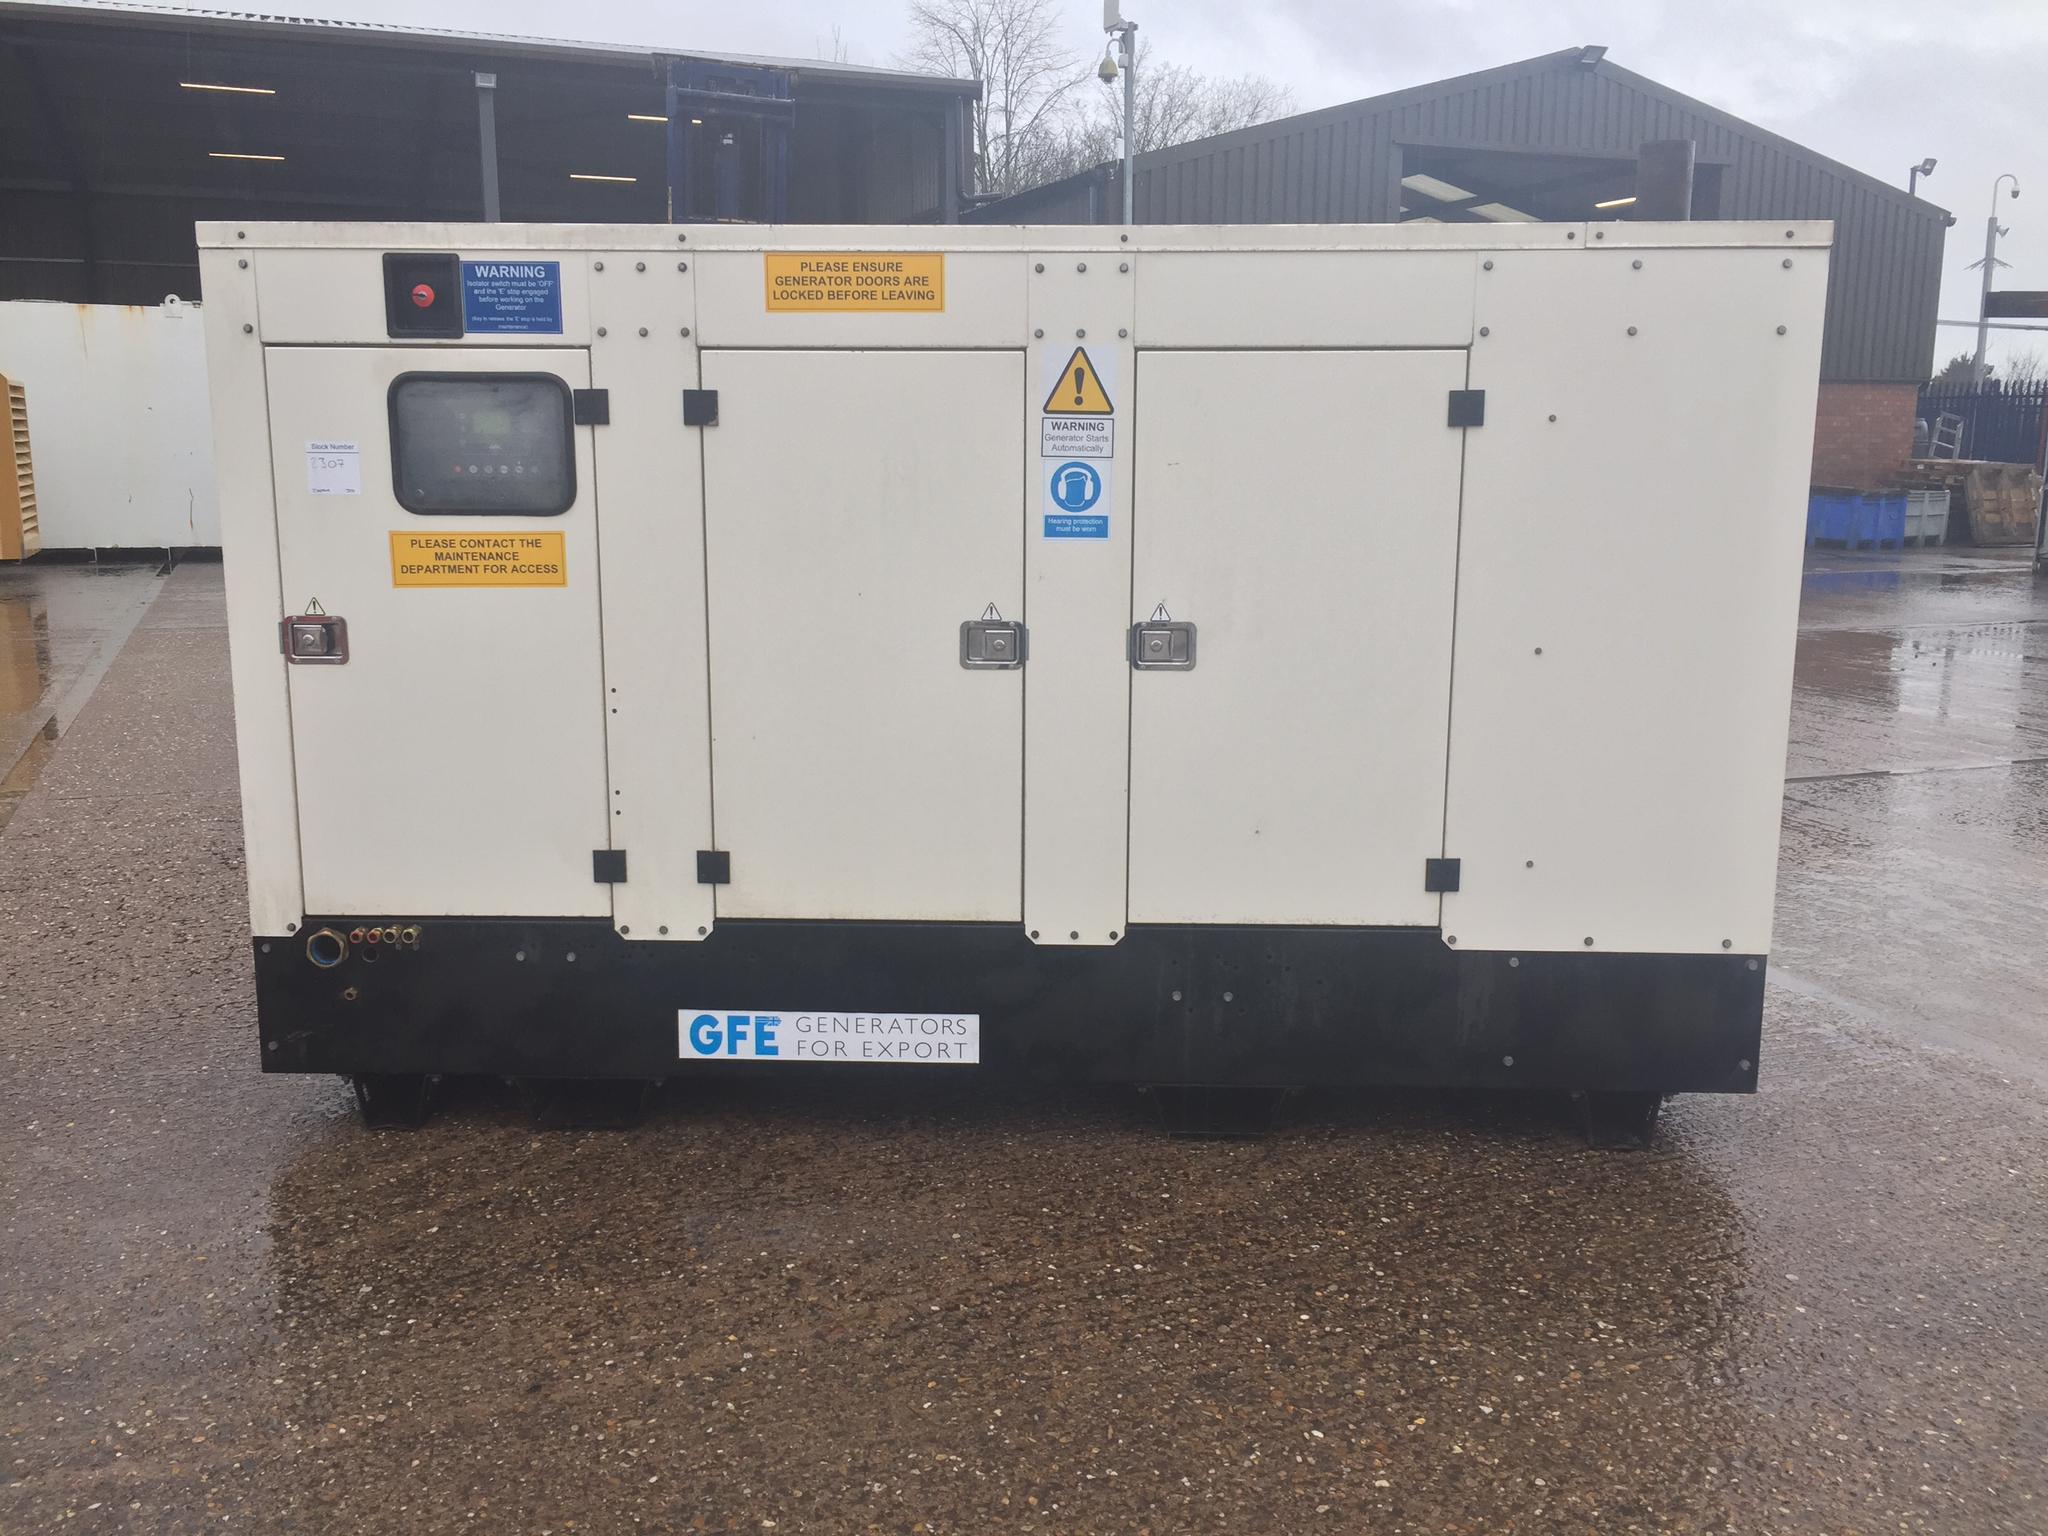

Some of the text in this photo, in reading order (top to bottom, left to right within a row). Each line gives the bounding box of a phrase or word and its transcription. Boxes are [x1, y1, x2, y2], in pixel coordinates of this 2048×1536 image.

[475, 265, 546, 278] WARNING
[800, 261, 903, 272] PLEASE ENSURE
[775, 276, 929, 286] GENERATOR DOORS ARE
[521, 288, 549, 296] engaged
[773, 290, 935, 300] LOCKED BEFORE LEAVING
[500, 296, 523, 304] working
[1051, 421, 1105, 431] WARNING
[1044, 433, 1109, 442] Generator Starts
[1051, 444, 1104, 454] Automatically
[410, 539, 542, 549] PLEASE CONTACT THE
[434, 552, 519, 561] MAINTENANCE
[401, 564, 559, 574] DEPARTMENT FOR ACCESS
[690, 1014, 968, 1056] GFE GENERATORS
[797, 1040, 968, 1059] FOR EXPORT
